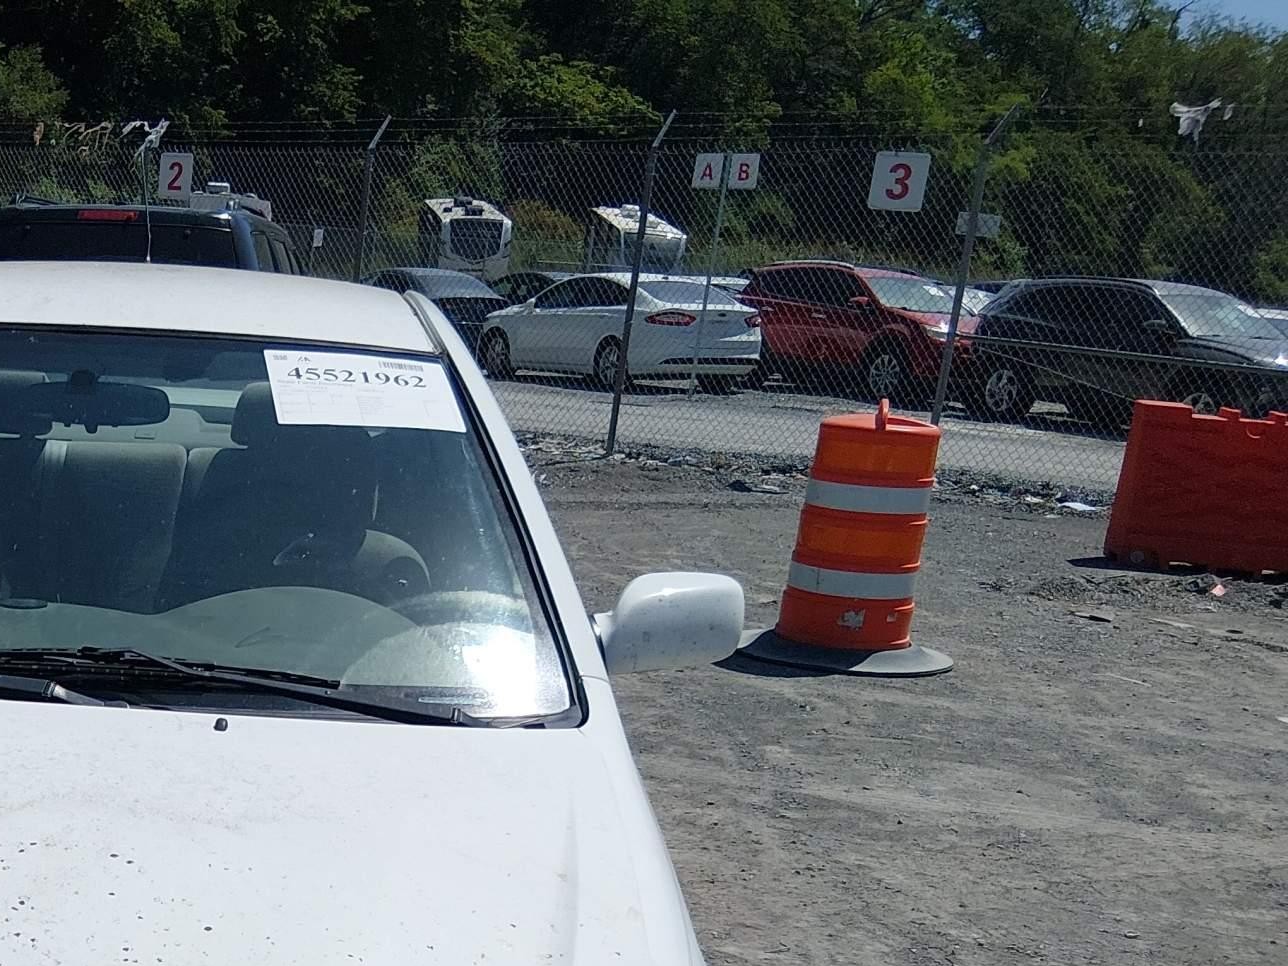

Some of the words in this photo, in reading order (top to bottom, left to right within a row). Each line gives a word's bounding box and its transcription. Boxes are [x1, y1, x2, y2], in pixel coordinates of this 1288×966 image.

[168, 163, 182, 190] 2
[700, 163, 713, 180] A
[737, 163, 750, 181] B
[885, 163, 912, 201] 3
[287, 367, 427, 388] 45521962
